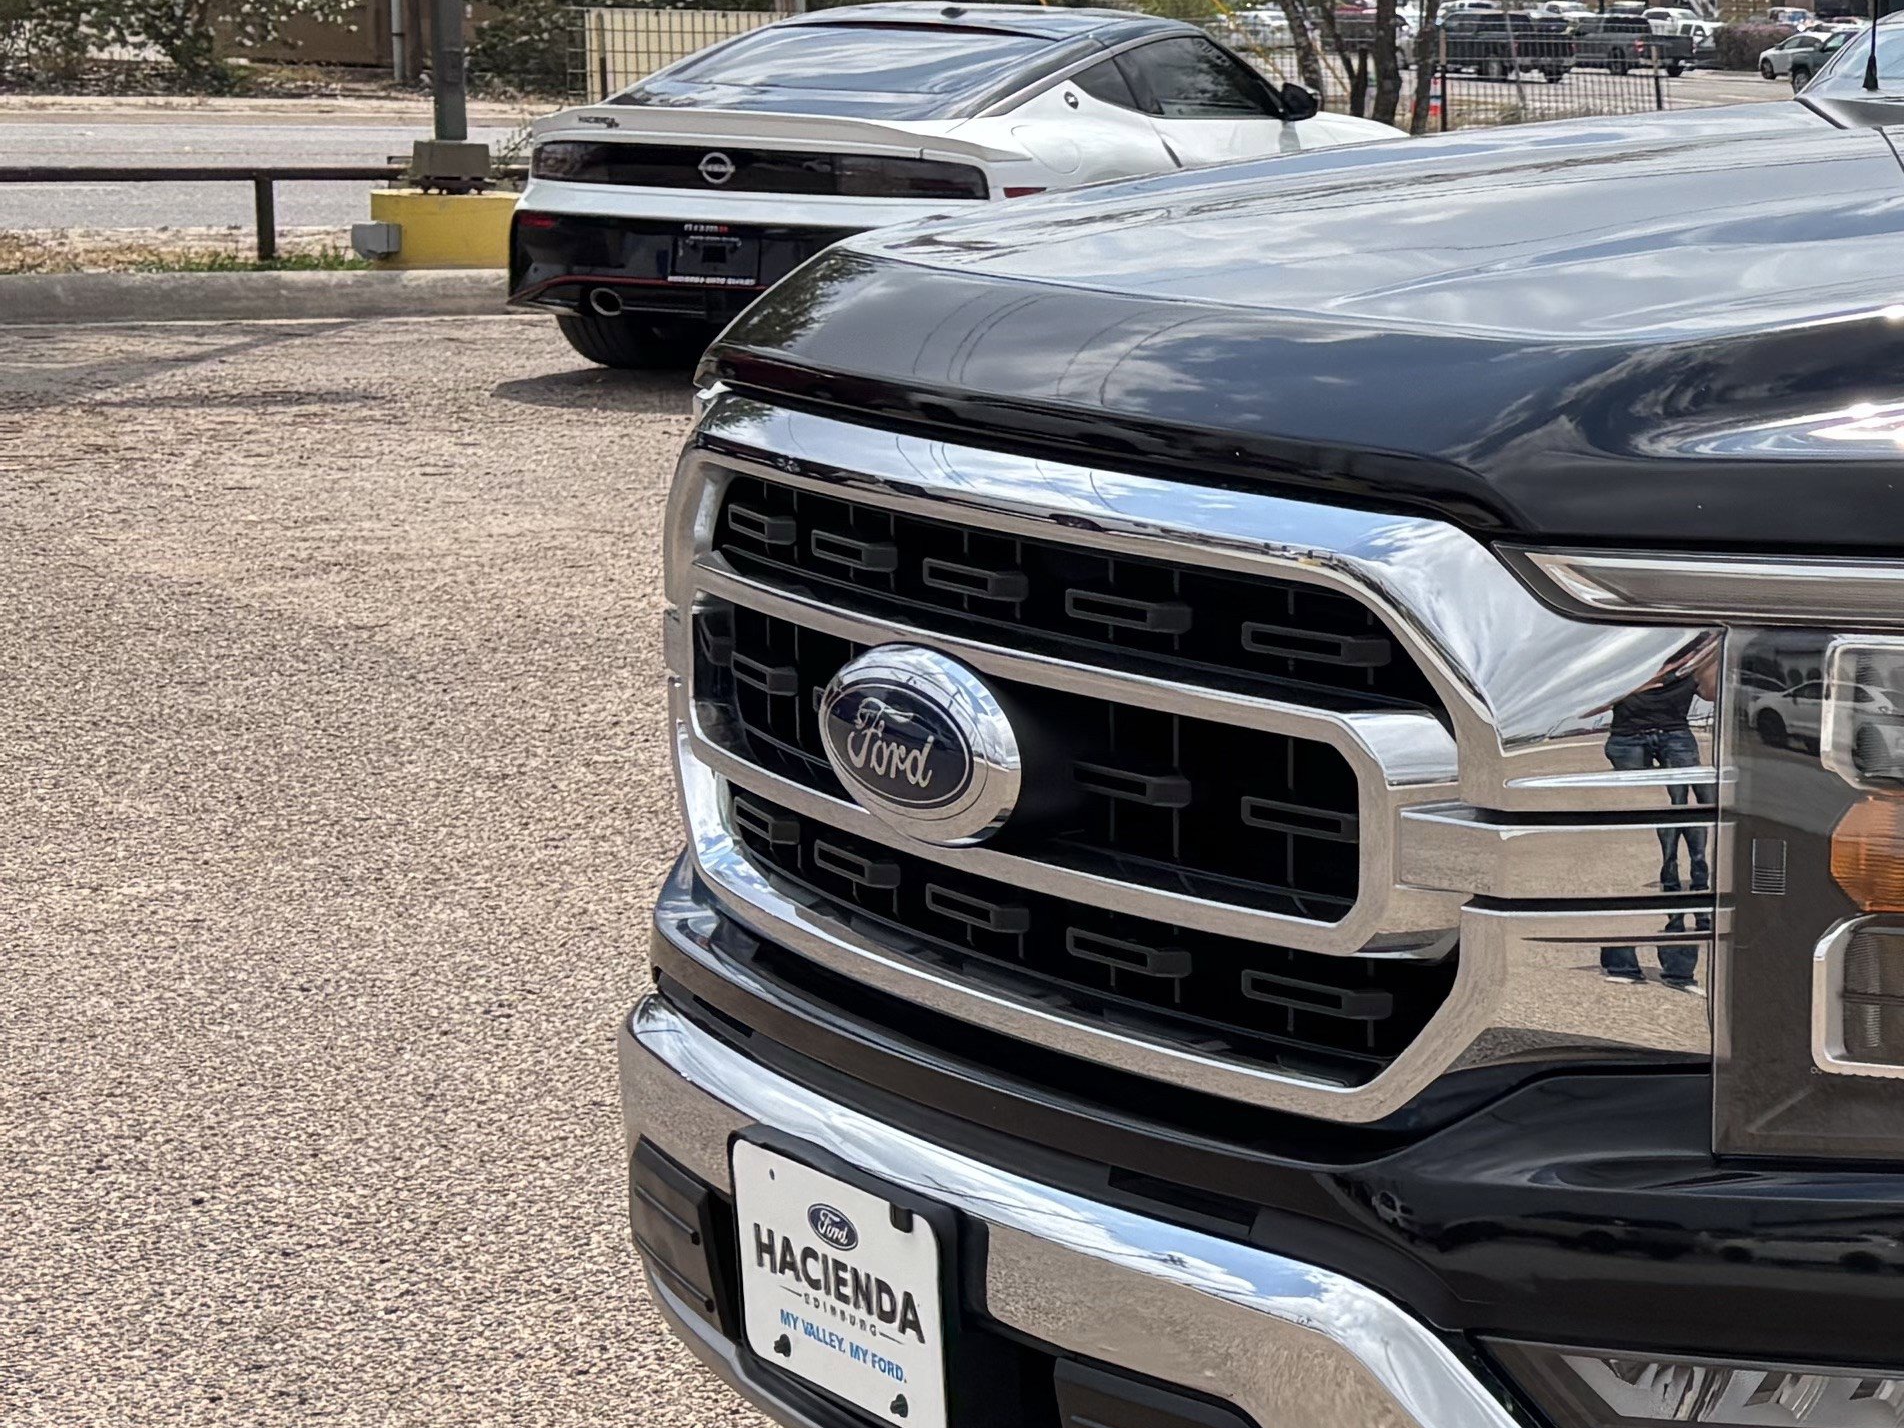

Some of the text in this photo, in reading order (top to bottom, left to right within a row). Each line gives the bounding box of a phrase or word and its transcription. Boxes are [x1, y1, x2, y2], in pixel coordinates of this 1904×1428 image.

[847, 696, 935, 788] Ford
[817, 1209, 850, 1246] Ford
[753, 1222, 927, 1345] HACIENDA
[780, 1308, 800, 1331] MY
[849, 1341, 870, 1365] MY
[803, 1292, 878, 1337] EDINBURG
